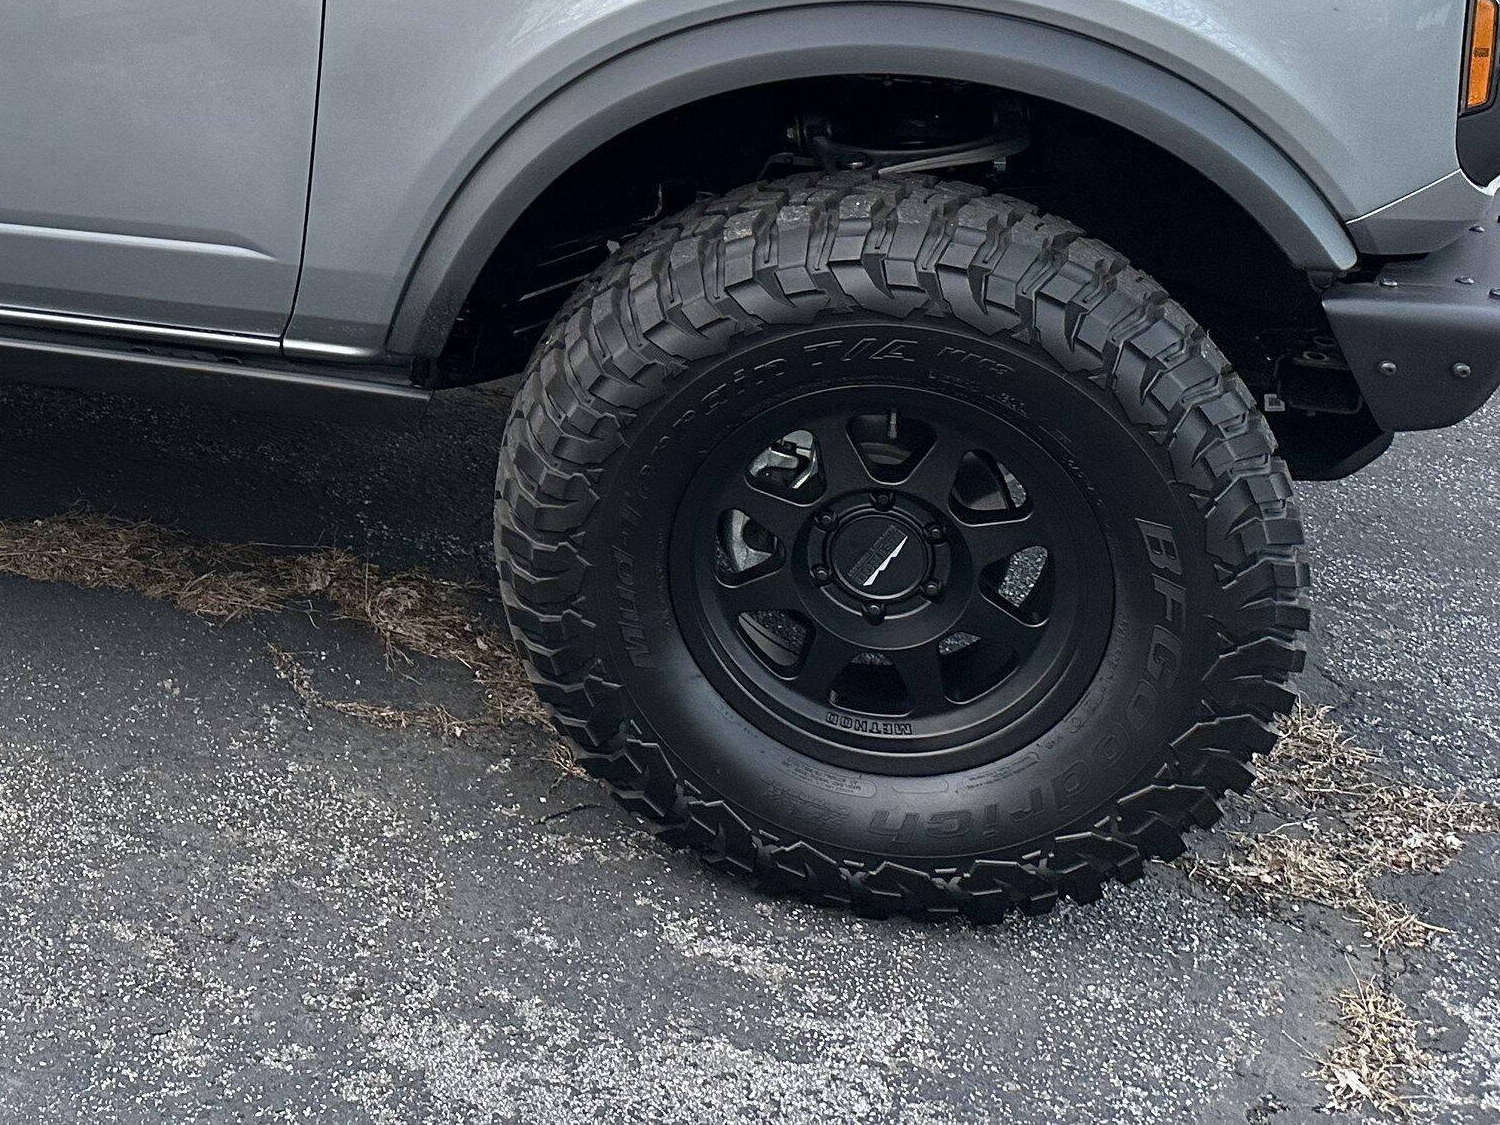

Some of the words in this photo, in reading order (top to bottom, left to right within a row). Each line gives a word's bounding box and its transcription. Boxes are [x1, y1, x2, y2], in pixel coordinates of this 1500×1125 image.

[801, 336, 918, 365] T/A
[867, 516, 1185, 845] BFGoodrich
[825, 712, 913, 736] METHOD
